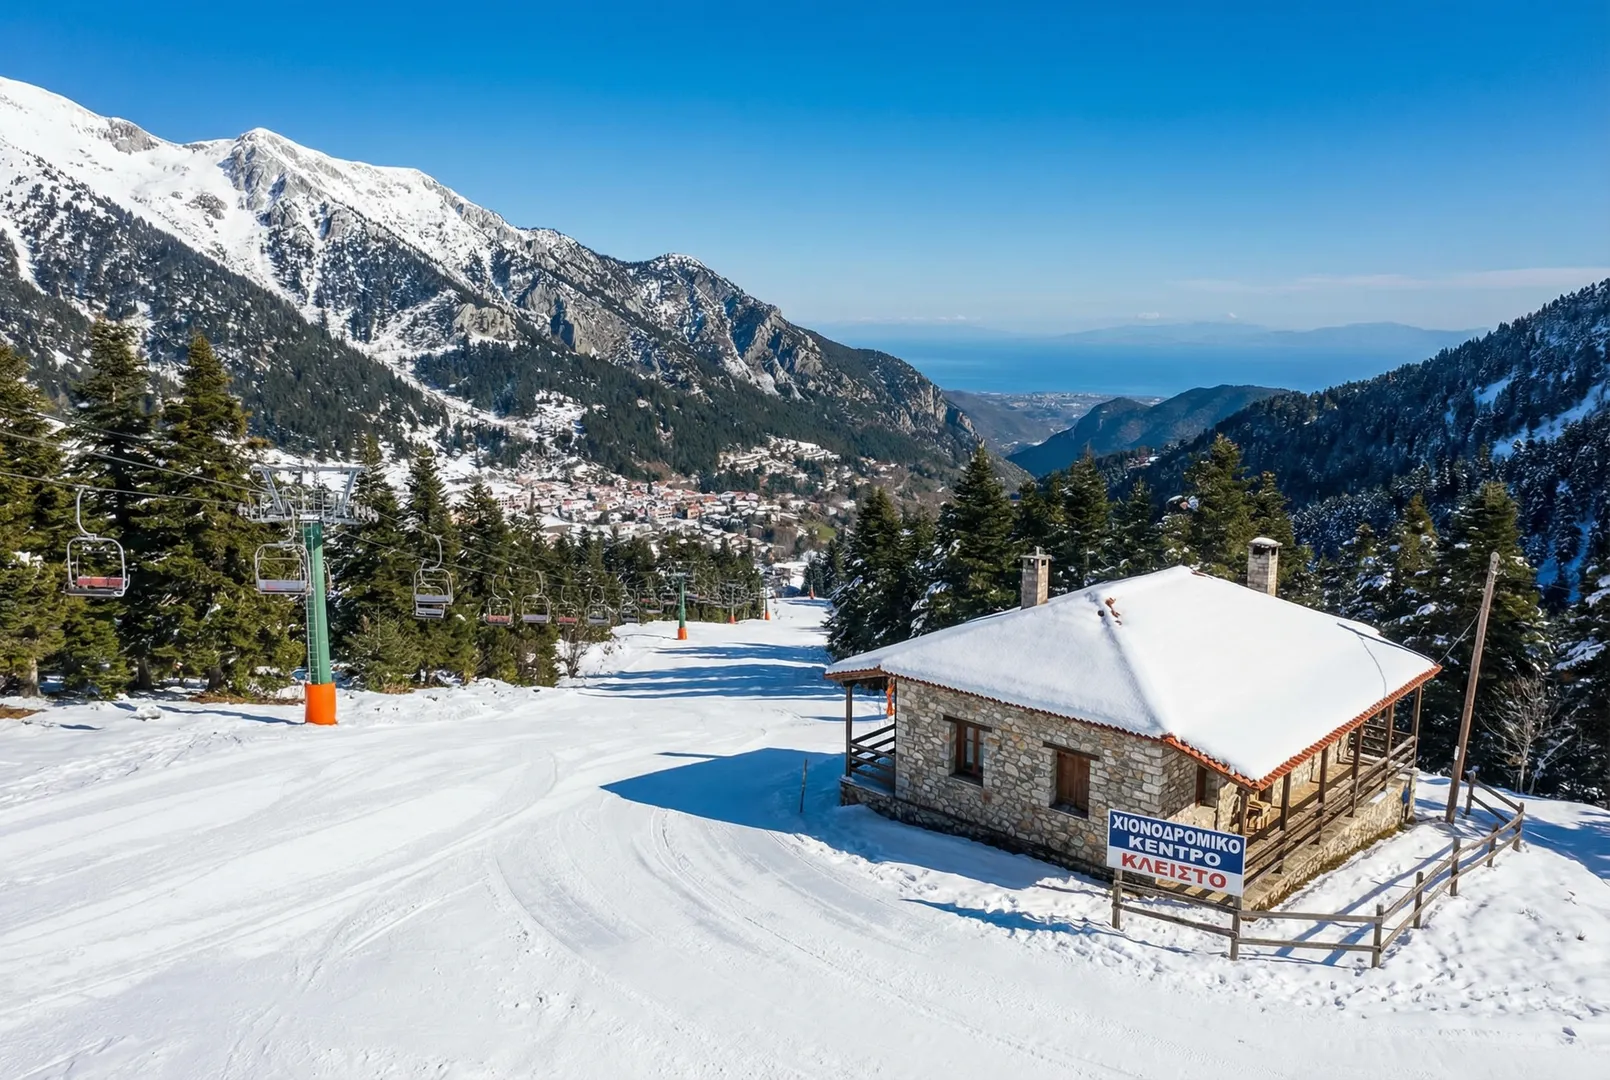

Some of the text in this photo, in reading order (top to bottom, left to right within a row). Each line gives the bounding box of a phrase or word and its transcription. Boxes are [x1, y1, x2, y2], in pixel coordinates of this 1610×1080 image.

[1112, 814, 1241, 854] ΧΙΟΝΟΔΡΟΜΙΚΟ
[1128, 835, 1221, 867] ΚΕΝΤΡΟ
[1121, 852, 1227, 889] ΚΛΕΙΣΤΟ
